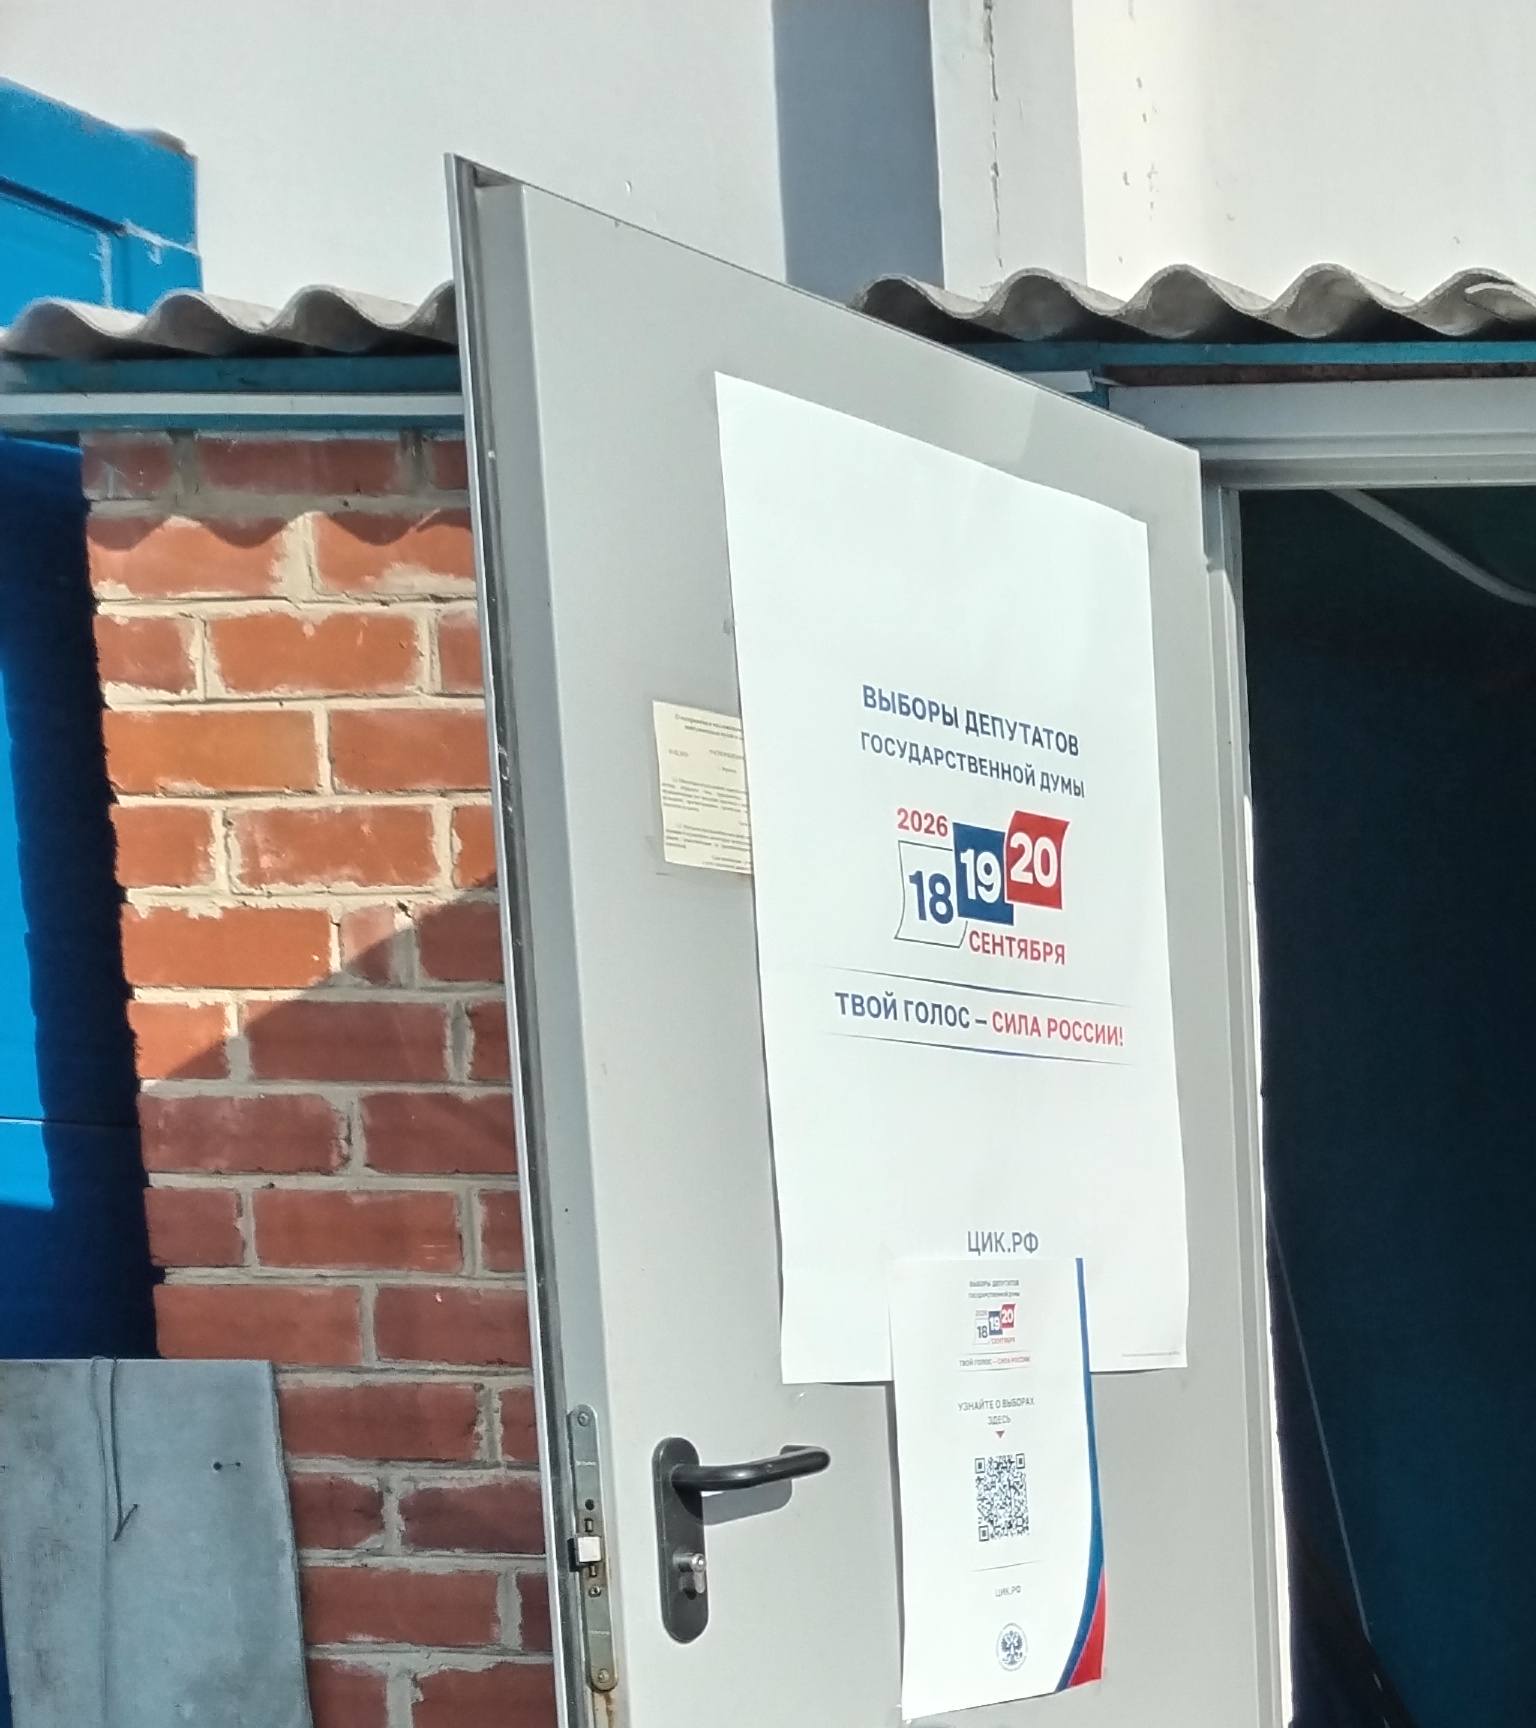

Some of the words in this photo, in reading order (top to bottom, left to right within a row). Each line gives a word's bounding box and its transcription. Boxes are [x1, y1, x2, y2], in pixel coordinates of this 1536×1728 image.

[862, 684, 959, 729] ВЫБОРЫ
[965, 709, 1080, 756] ДЕПУТАТОВ
[860, 731, 1036, 787] ГОСУДАРСТВЕННОЙ
[1040, 771, 1085, 799] ДУМЫ
[896, 807, 949, 837] 2026
[908, 870, 954, 924] 18
[960, 848, 1001, 904] 19
[1009, 831, 1058, 888] 20
[969, 930, 1066, 965] СЕНТЯБРЯ
[835, 991, 898, 1020] ТВОЙ
[904, 1000, 970, 1029] ГОЛОС
[992, 1010, 1042, 1038] СИЛА
[1047, 1017, 1124, 1046] РОССИИ!
[967, 1230, 1039, 1256] ЦИК.РФ
[976, 1325, 988, 1339] 18
[989, 1316, 1000, 1331] 19
[1001, 1308, 1014, 1324] 20
[957, 1398, 994, 1412] УЗНАЙТЕ
[995, 1399, 1001, 1409] О
[1002, 1397, 1035, 1408] ВЫБОРАХ
[987, 1415, 1011, 1426] ЗДЕСЬ
